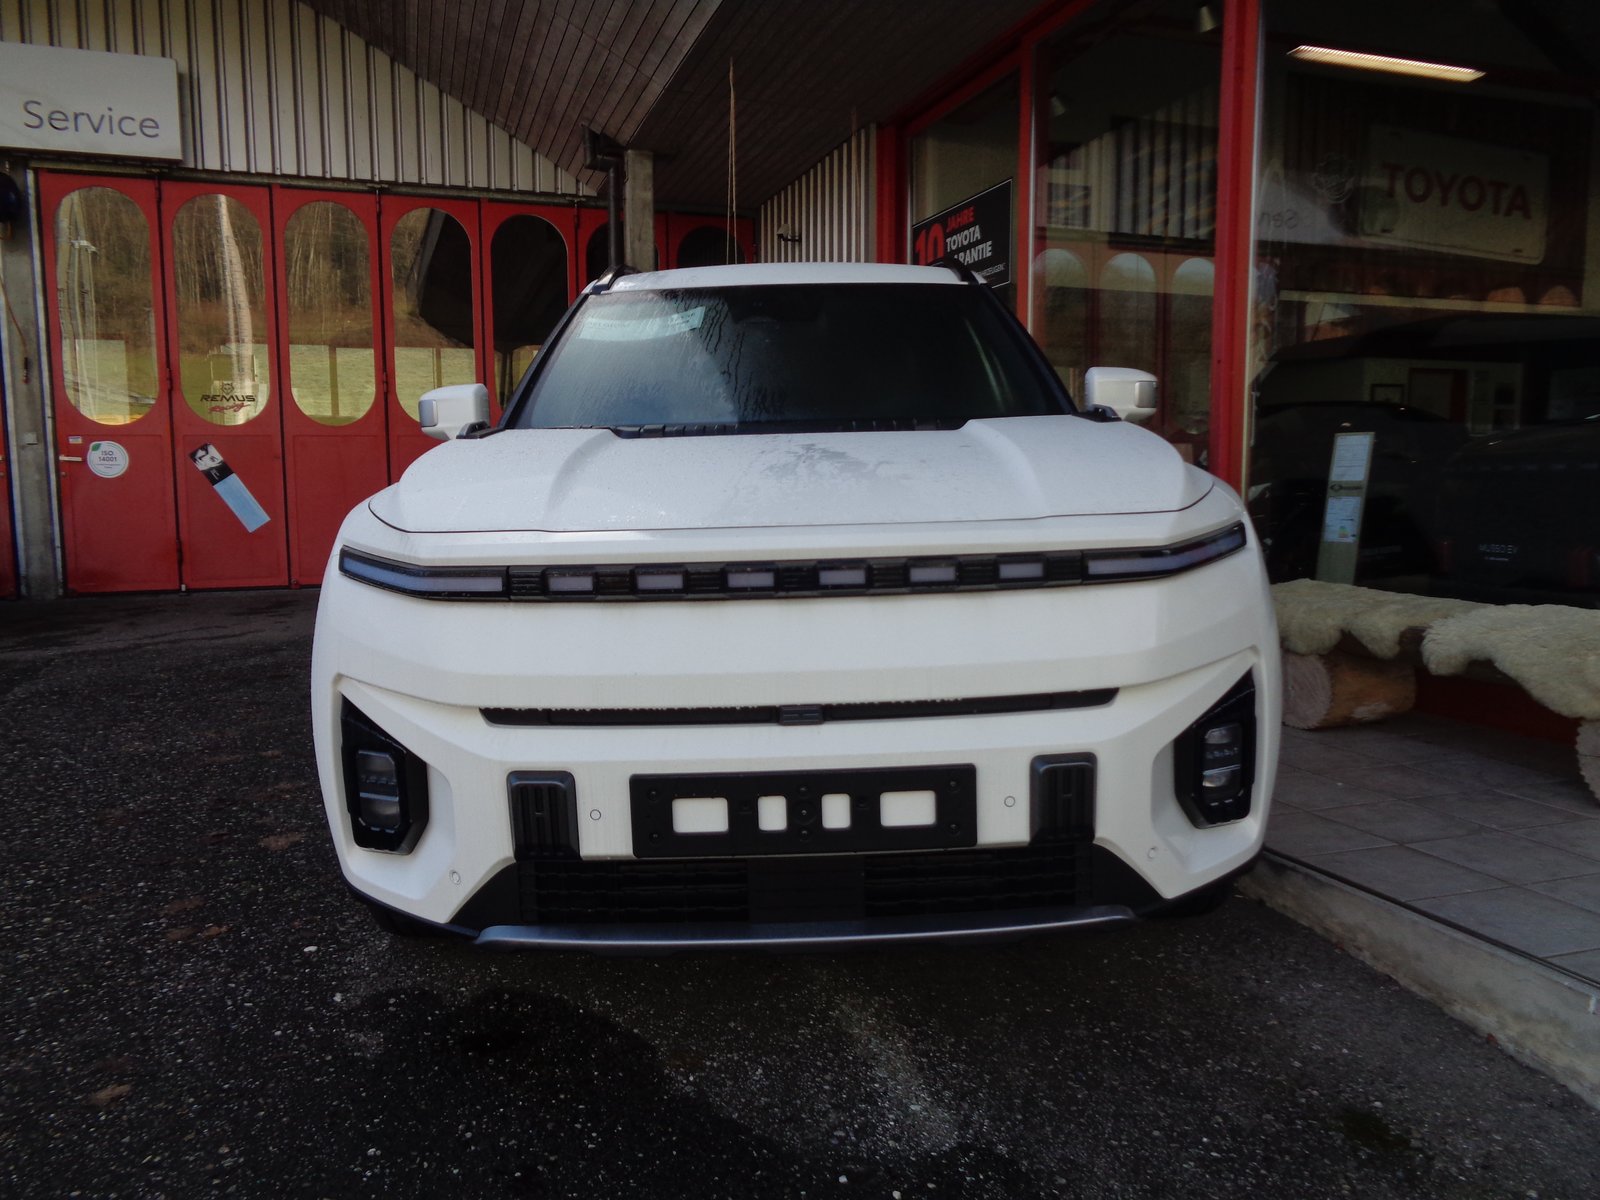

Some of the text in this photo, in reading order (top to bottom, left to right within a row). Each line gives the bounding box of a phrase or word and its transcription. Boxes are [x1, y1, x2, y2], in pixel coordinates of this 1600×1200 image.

[23, 99, 160, 138] Service
[1381, 161, 1532, 220] TOYOTA
[946, 206, 976, 233] JAHRE
[915, 223, 944, 266] 10
[945, 224, 981, 253] TOYOTA
[200, 394, 256, 402] REMUS
